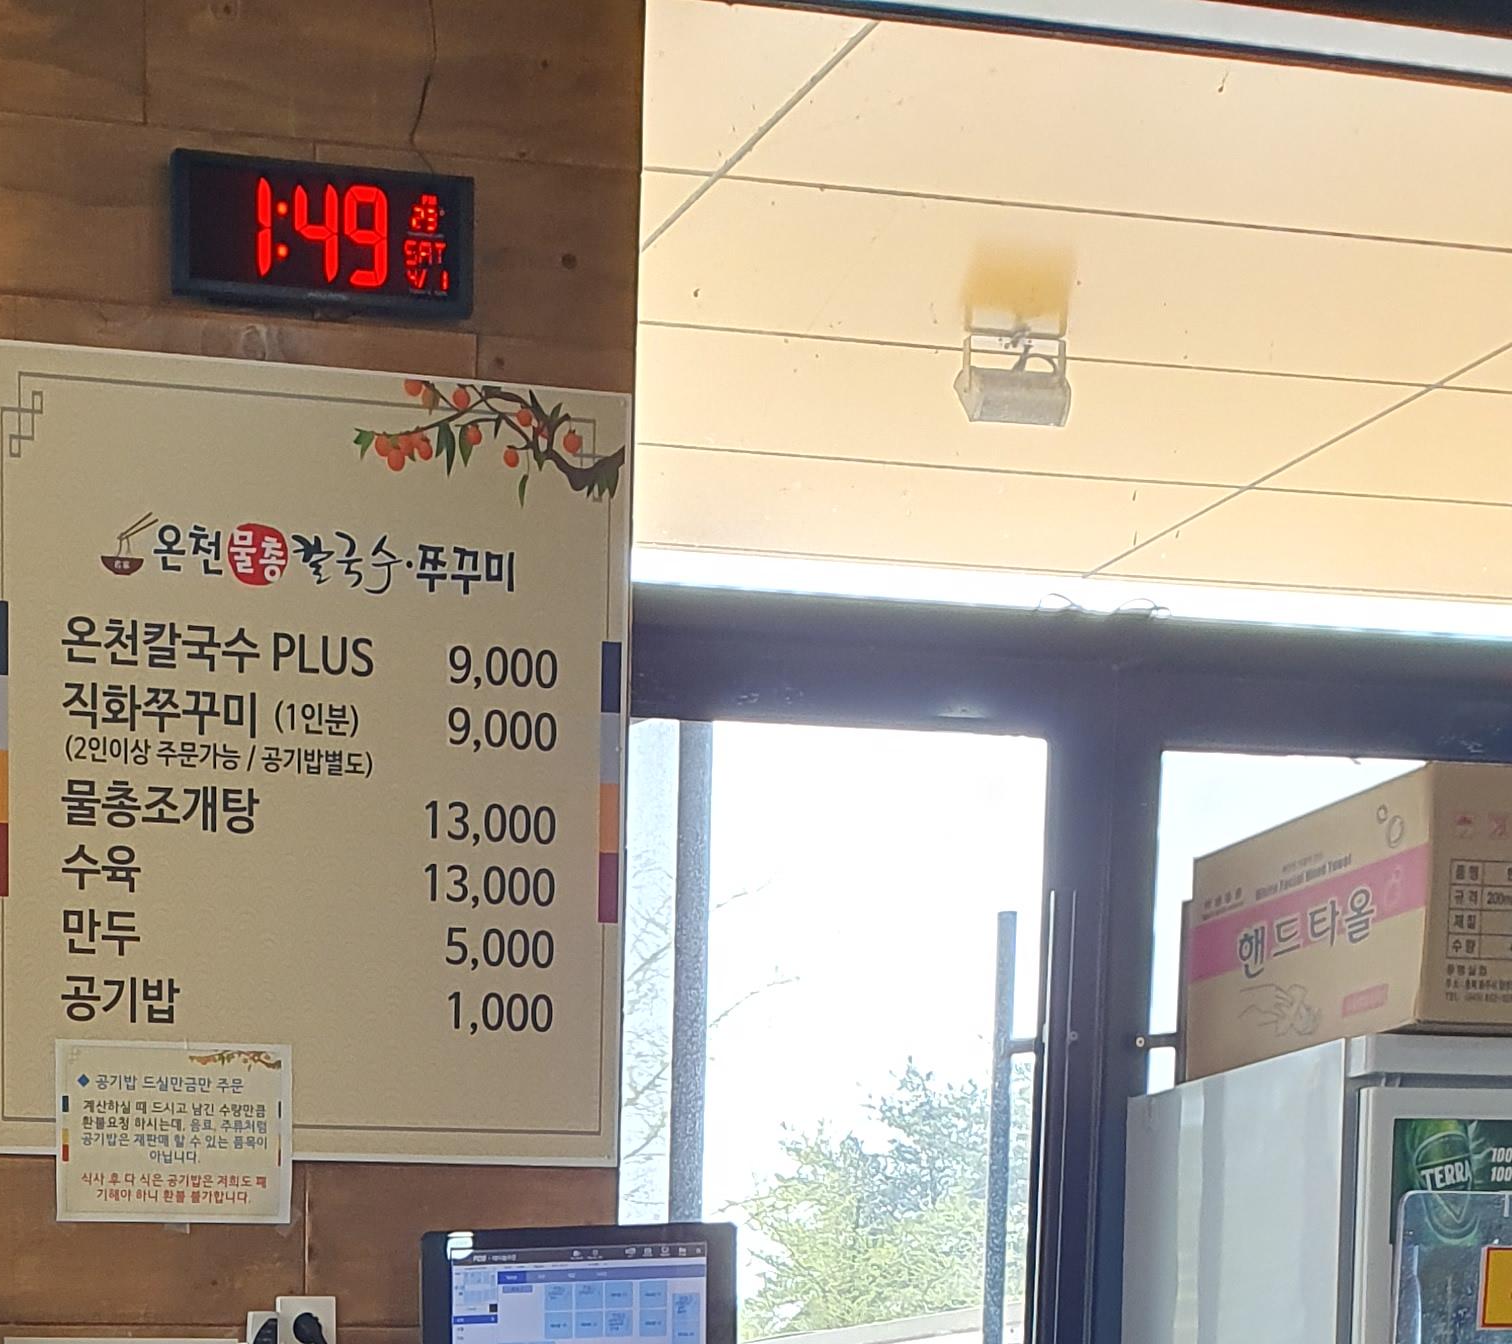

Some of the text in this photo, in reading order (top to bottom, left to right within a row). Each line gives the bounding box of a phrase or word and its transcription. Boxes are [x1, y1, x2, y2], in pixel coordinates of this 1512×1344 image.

[256, 176, 388, 289] 1:49
[404, 239, 447, 266] SAT
[61, 615, 374, 677] 온천칼국수 PLUS
[448, 645, 558, 689] 9,000
[62, 682, 359, 738] 직화쭈꾸미 (1인분)
[447, 706, 557, 752] 9,000
[65, 735, 151, 766] (2인이상
[156, 740, 240, 771] 주문가능
[261, 746, 373, 778] 공기밥별도)
[61, 779, 260, 834] 물총조개탕
[424, 800, 556, 846] 13,000
[61, 843, 142, 893] 수육
[424, 863, 556, 909] 13,000
[62, 908, 141, 957] 만두
[445, 926, 555, 971] 5,000
[1237, 886, 1376, 980] 핸드타올
[61, 975, 181, 1024] 공기밥
[447, 990, 554, 1035] 1,000
[95, 1074, 138, 1091] 공기밥
[216, 1077, 244, 1094] 주문
[82, 1099, 266, 1119] 계산하실 때 드시고 남긴 수량만큼
[81, 1132, 131, 1147] 공기밥은
[189, 1134, 201, 1150] 수
[205, 1134, 229, 1150] 있는
[149, 1150, 201, 1165] 아닙니다.
[135, 1188, 158, 1203] 하니
[140, 1173, 164, 1188] 식은
[167, 1173, 214, 1189] 공기밥은
[217, 1175, 253, 1189] 저희도
[1419, 1158, 1473, 1192] TERRA
